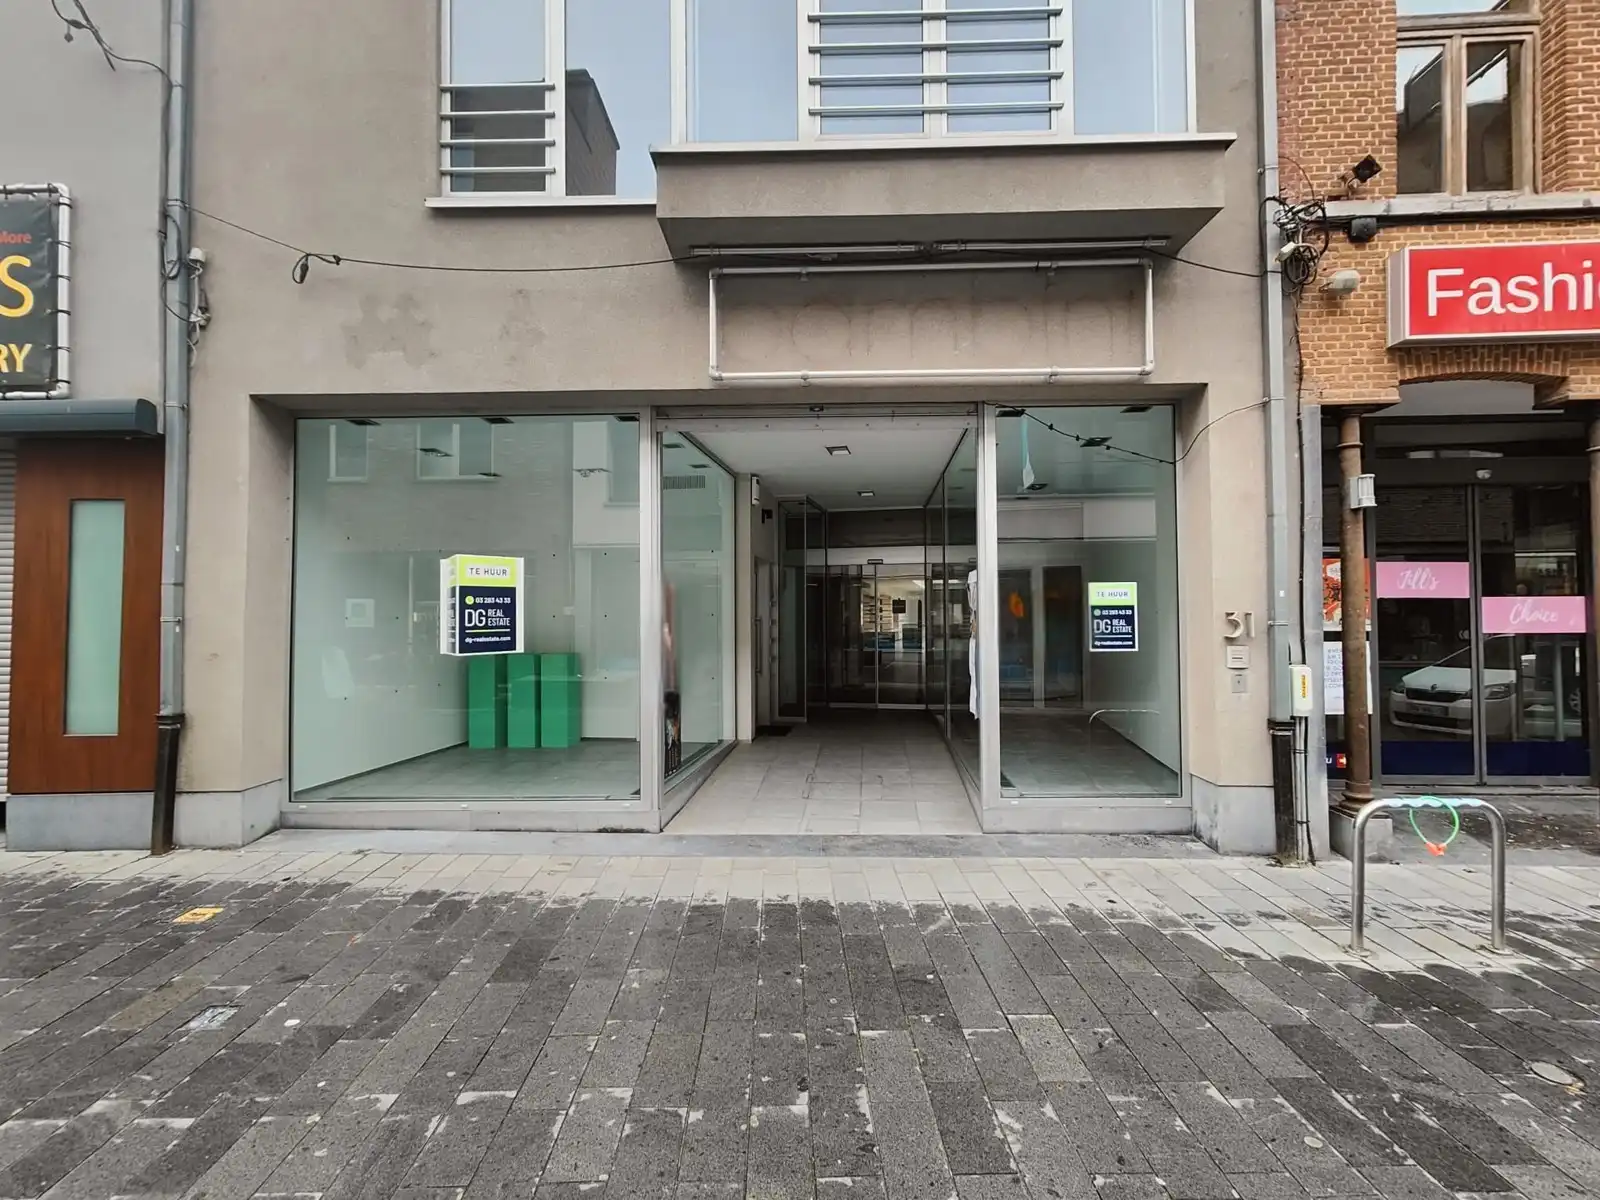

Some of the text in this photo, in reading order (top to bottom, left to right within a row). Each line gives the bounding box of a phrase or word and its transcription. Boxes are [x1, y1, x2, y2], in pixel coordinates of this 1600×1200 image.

[1427, 259, 1600, 317] Fashi
[484, 568, 507, 576] HUUR
[464, 608, 504, 626] DG REAL
[1509, 598, 1558, 625] Choice
[487, 617, 511, 627] ESTATE
[1094, 620, 1111, 633] DG
[1112, 625, 1132, 633] ESTATE
[1223, 610, 1255, 639] 31
